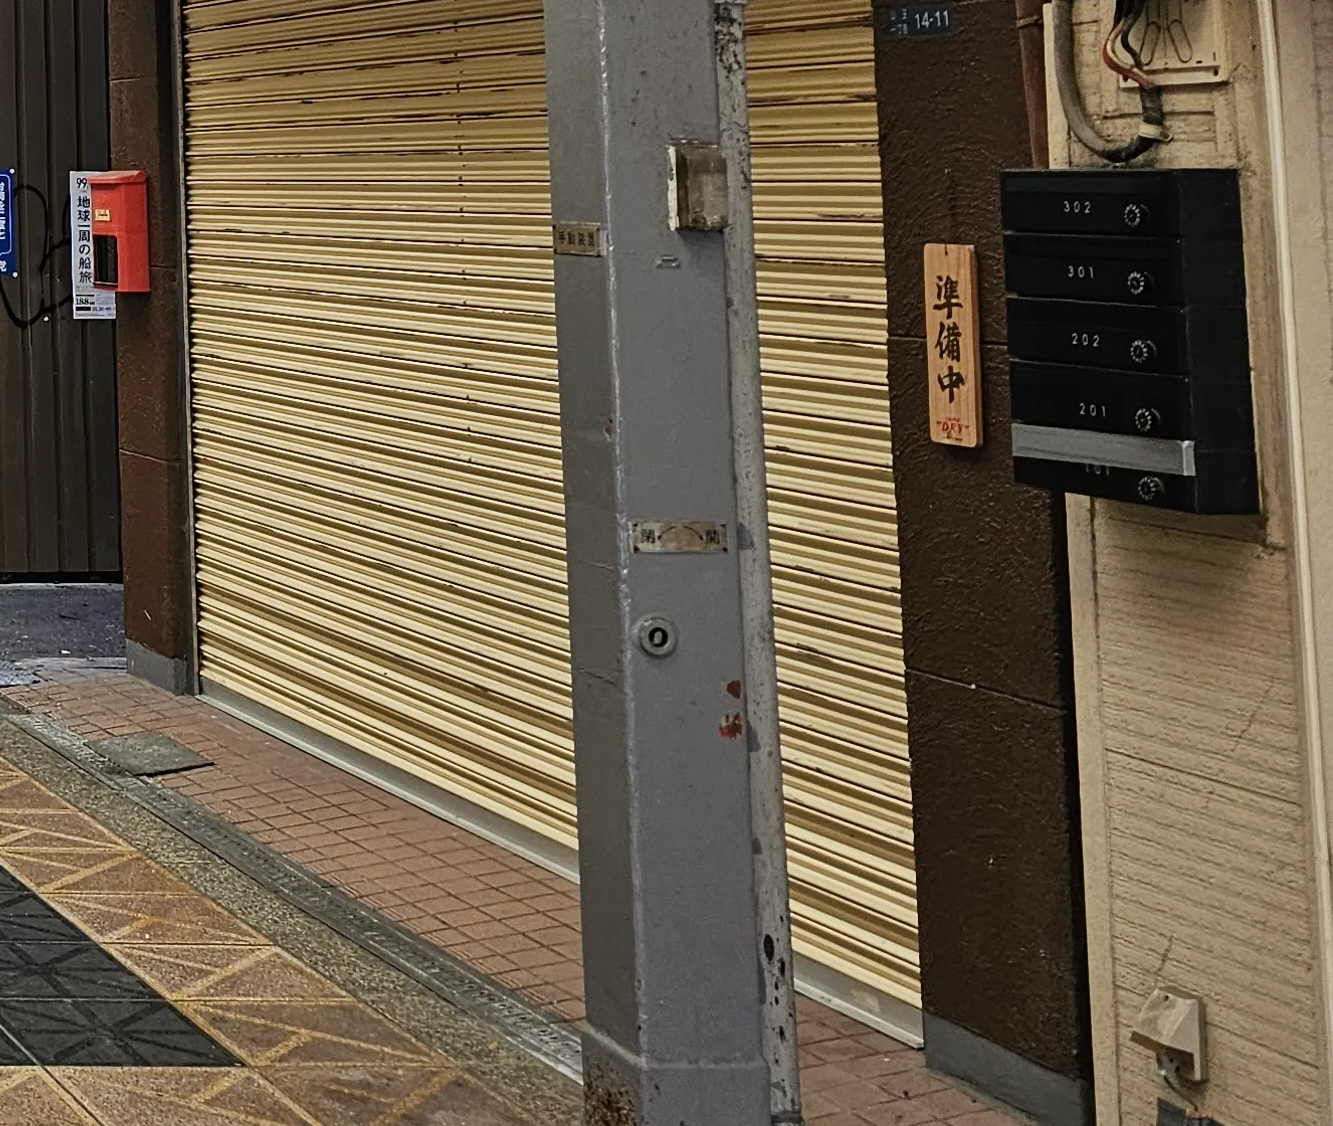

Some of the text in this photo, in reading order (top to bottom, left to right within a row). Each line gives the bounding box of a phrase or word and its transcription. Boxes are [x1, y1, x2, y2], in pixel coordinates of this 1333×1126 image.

[1063, 200, 1091, 214] 302
[77, 195, 93, 284] 地球一周の船旅
[1068, 264, 1094, 279] 301
[933, 274, 965, 404] 準備中
[1071, 332, 1101, 347] 202
[1079, 402, 1106, 417] 201
